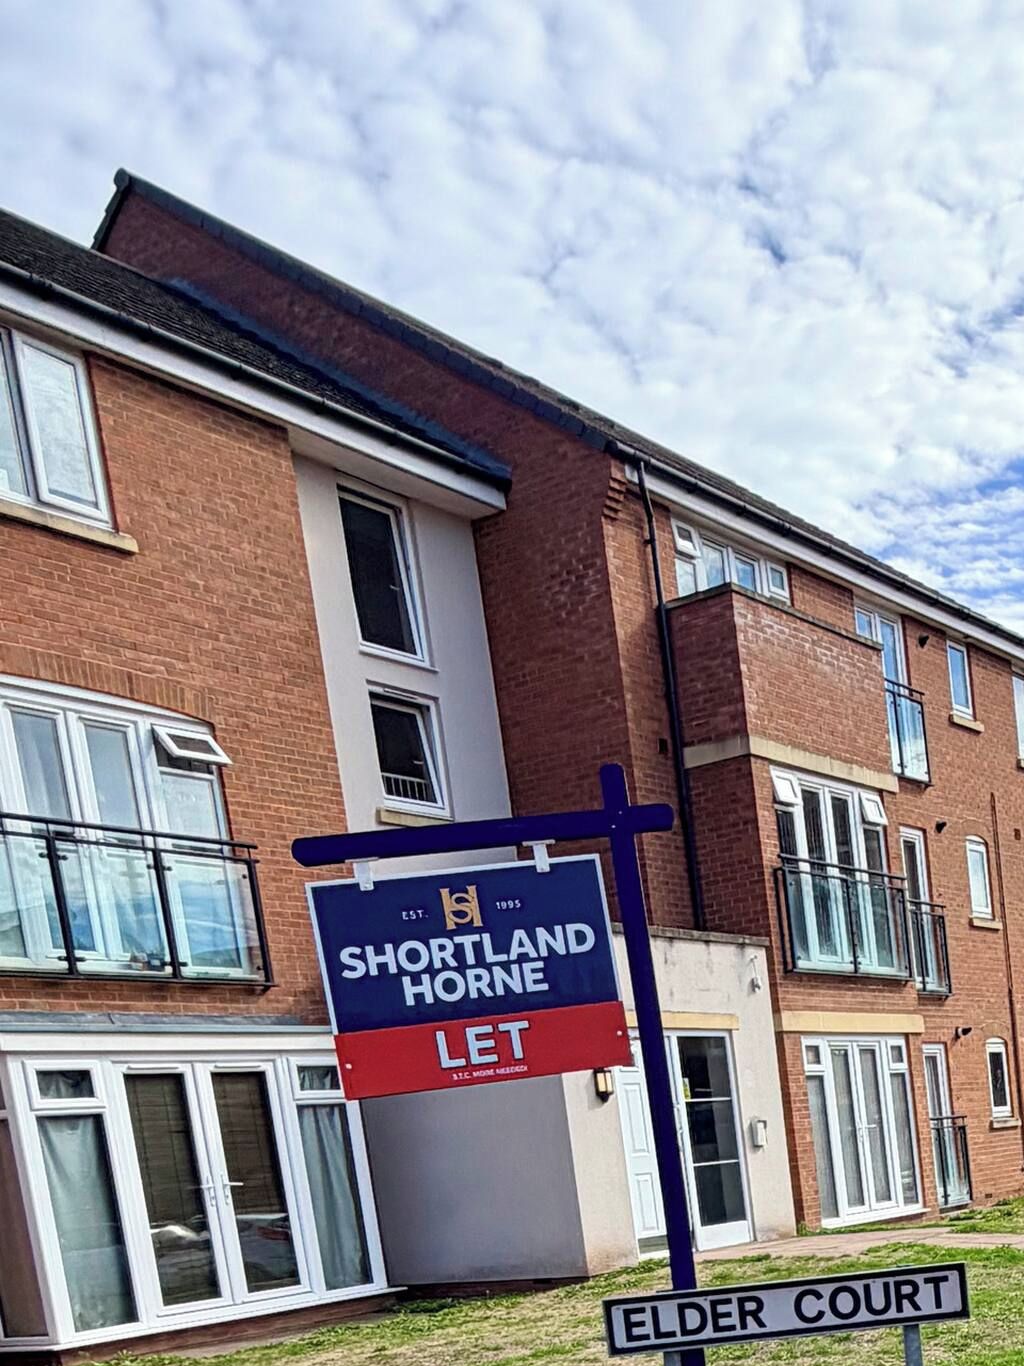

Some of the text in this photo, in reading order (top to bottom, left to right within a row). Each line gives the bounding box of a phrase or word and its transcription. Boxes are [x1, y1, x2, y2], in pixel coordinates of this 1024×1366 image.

[402, 900, 521, 920] EST. 1995
[339, 923, 596, 979] SHORTLAND
[401, 961, 549, 1006] HORNE
[436, 1021, 530, 1069] LET
[622, 1274, 949, 1343] ELDER COURT
